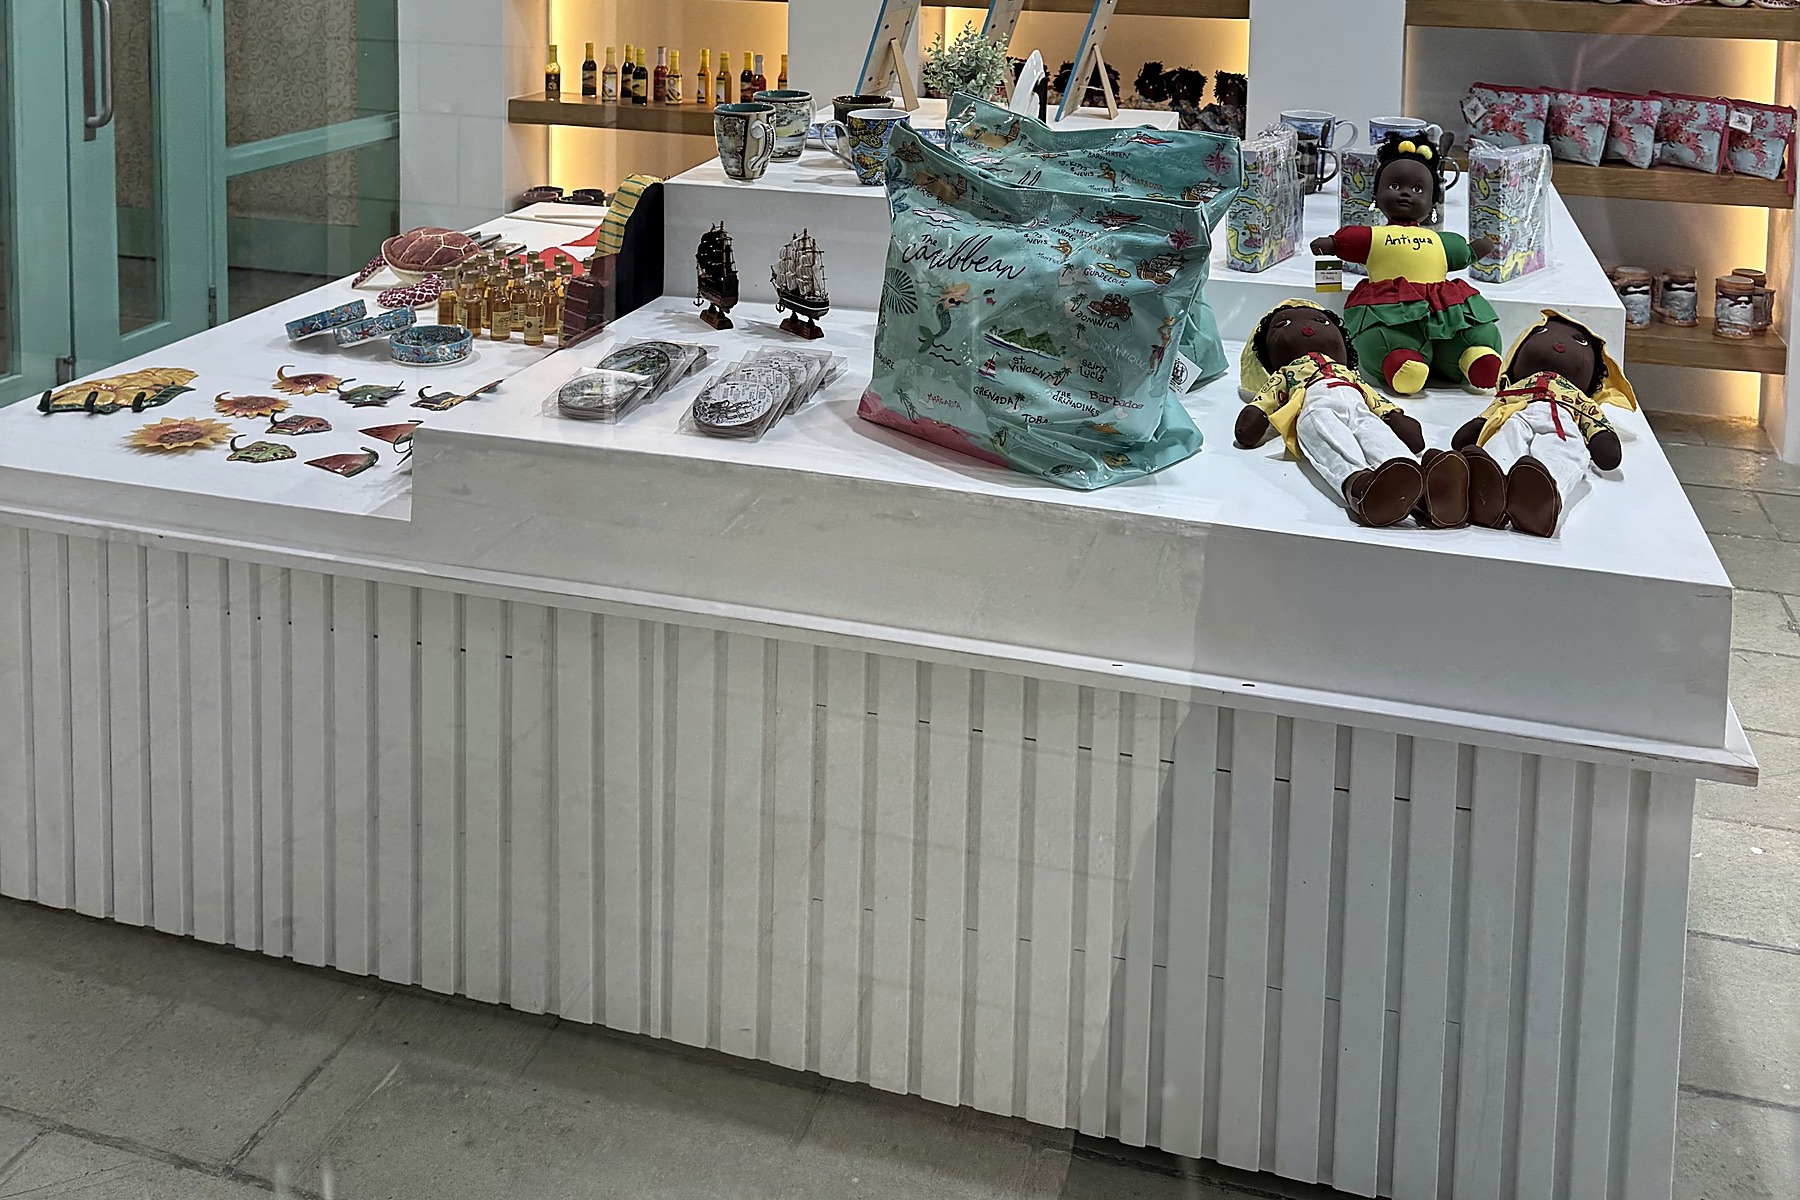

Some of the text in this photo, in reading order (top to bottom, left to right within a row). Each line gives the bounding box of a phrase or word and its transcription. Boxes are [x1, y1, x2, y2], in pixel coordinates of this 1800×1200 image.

[922, 234, 938, 246] The
[1384, 234, 1434, 251] Antigua
[1075, 310, 1121, 331] DOMINICA
[1008, 363, 1053, 382] VINCENT
[973, 386, 1014, 405] GRENADA
[1056, 390, 1072, 399] THE
[1088, 390, 1145, 410] Barbados
[1052, 394, 1101, 417] GRENADINES
[1021, 413, 1050, 425] TOBA
